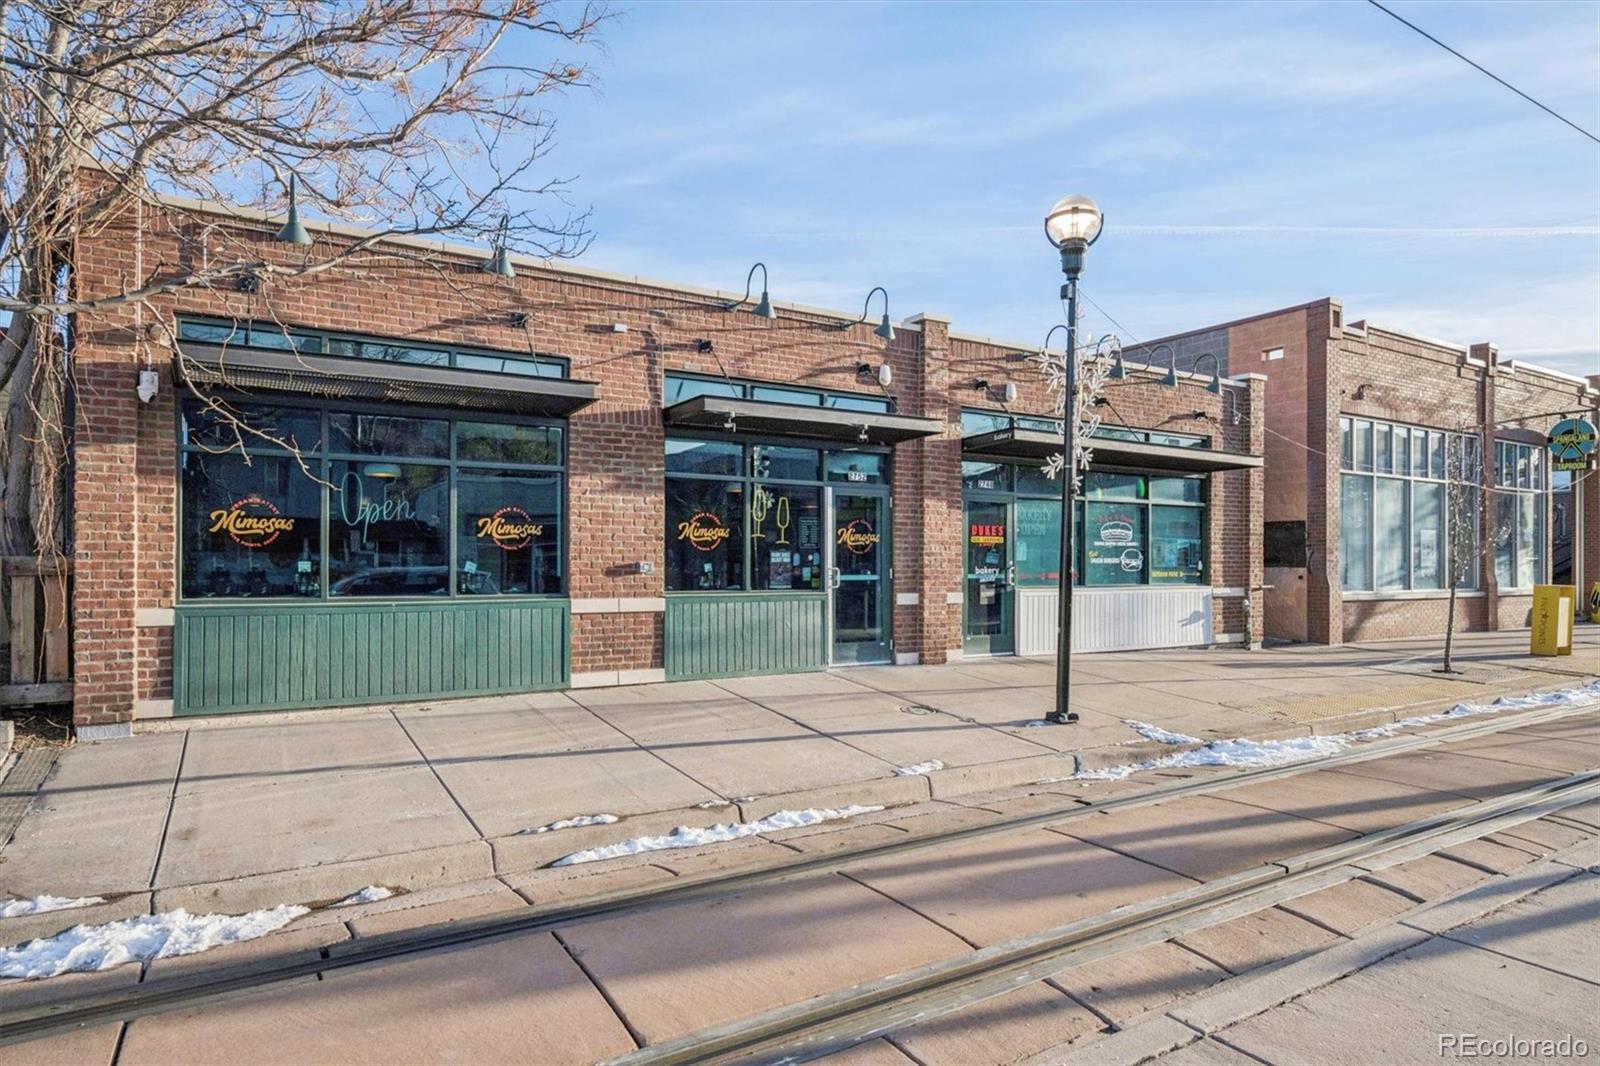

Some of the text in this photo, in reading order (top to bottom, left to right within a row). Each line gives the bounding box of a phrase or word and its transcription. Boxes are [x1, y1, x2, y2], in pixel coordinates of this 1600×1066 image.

[1558, 462, 1587, 470] TAPROOM
[341, 471, 415, 543] Open
[208, 509, 296, 536] Mimosas
[477, 517, 543, 540] Mimosas
[678, 522, 730, 541] Mimosas
[971, 524, 1004, 536] DUKE'S
[837, 528, 880, 545] Mimosas
[975, 568, 999, 577] bakery
